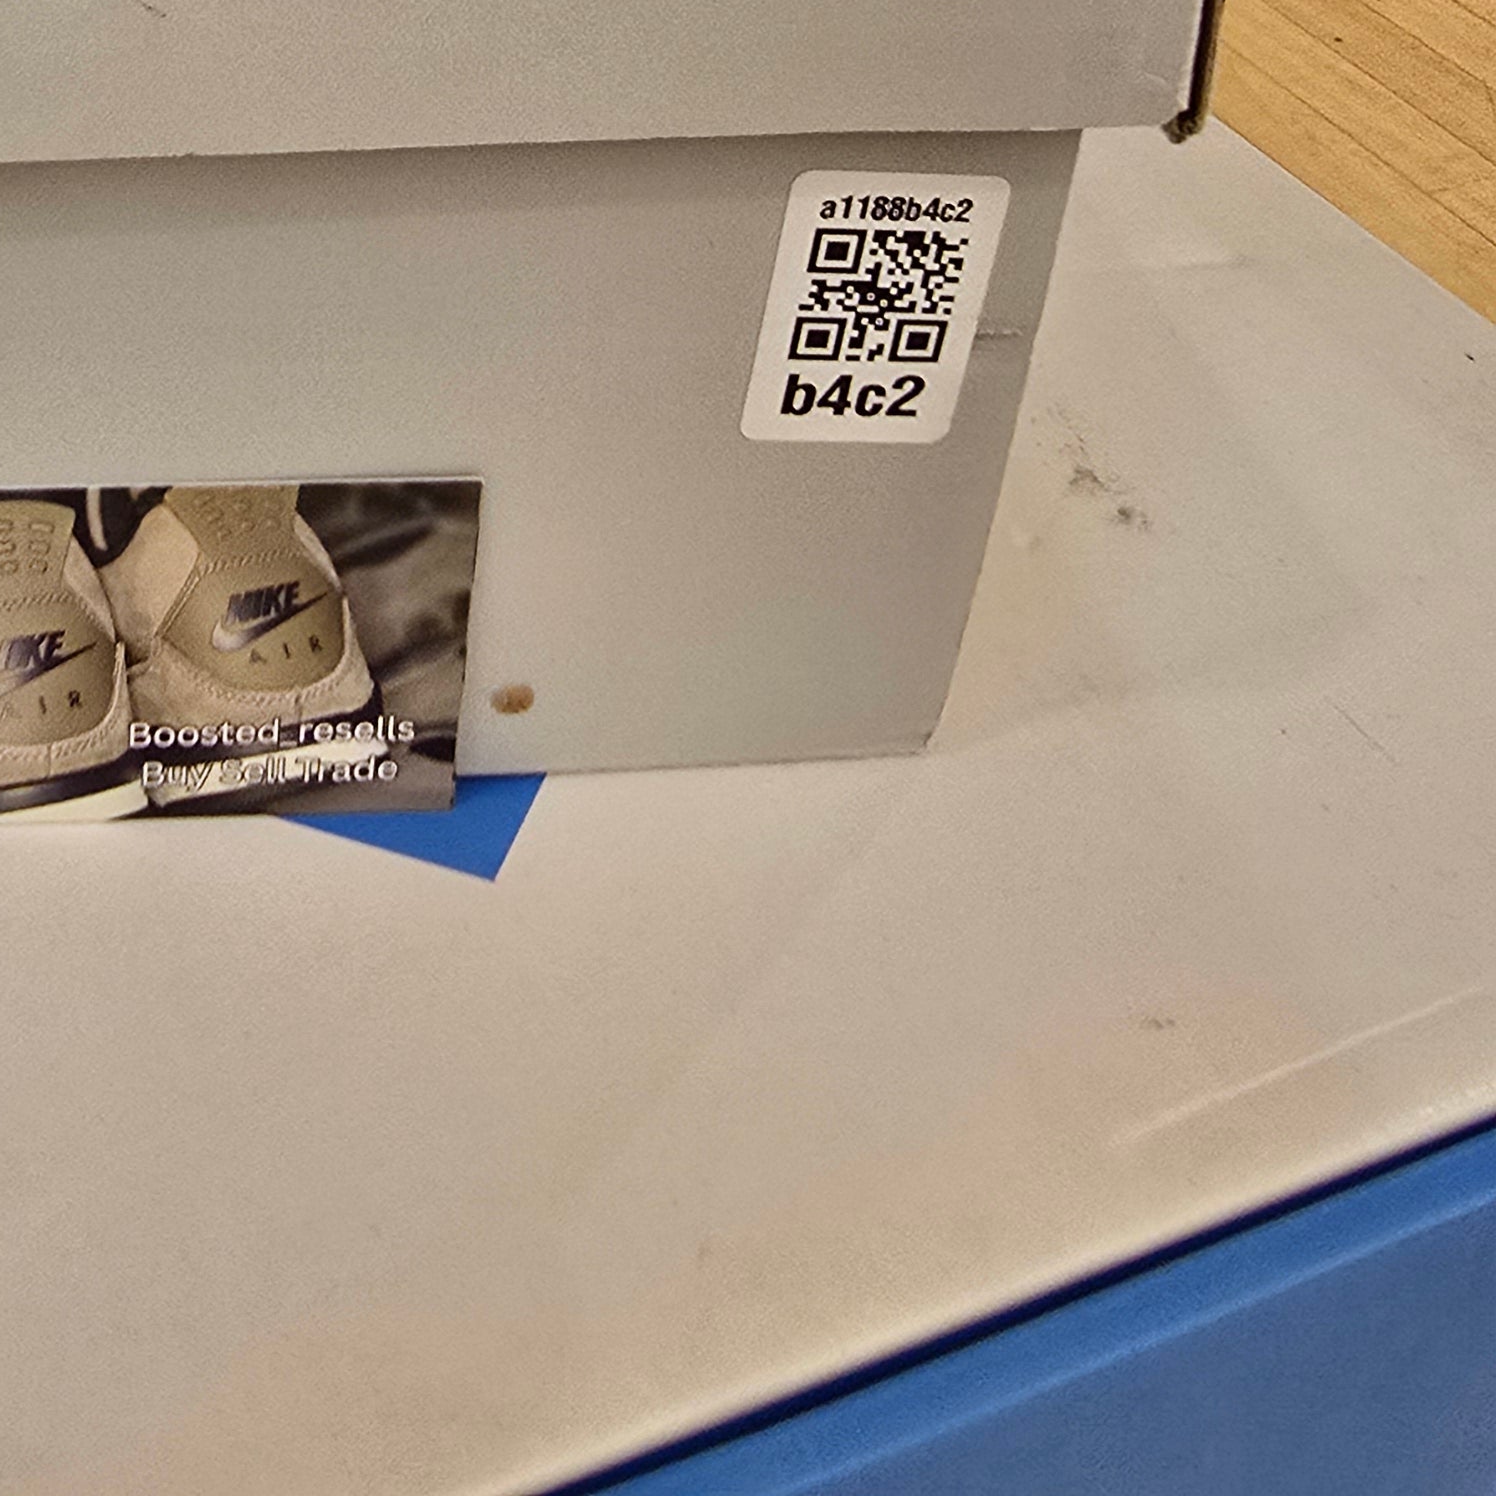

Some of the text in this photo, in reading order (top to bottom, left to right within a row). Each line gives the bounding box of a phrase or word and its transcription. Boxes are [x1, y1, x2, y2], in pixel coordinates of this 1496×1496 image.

[819, 195, 974, 223] a1188b4c2
[780, 373, 926, 417] b4c2
[226, 580, 301, 626] NIKE
[128, 715, 415, 749] Boosted_resells
[141, 755, 398, 791] Buy Sell Trade
